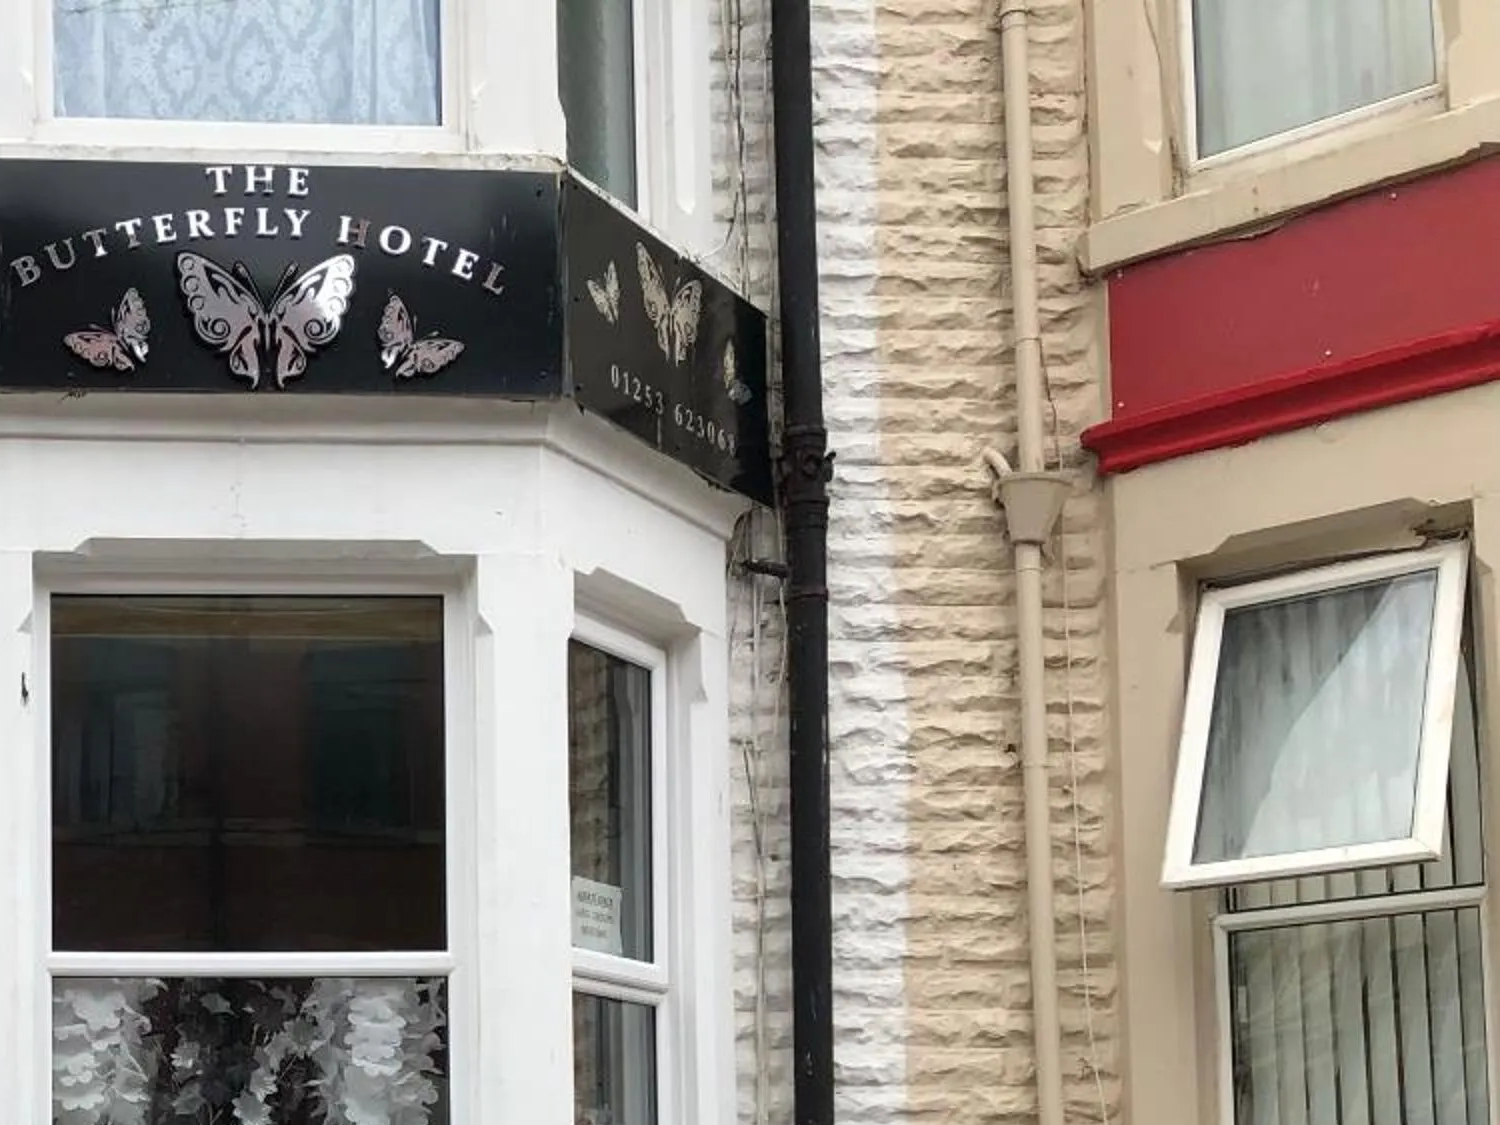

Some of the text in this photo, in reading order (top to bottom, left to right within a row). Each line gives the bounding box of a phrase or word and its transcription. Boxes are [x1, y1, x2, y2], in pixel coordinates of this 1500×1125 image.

[204, 165, 311, 196] THE
[9, 207, 507, 296] BUTTERFLY HOTEL
[610, 363, 665, 415] 01253
